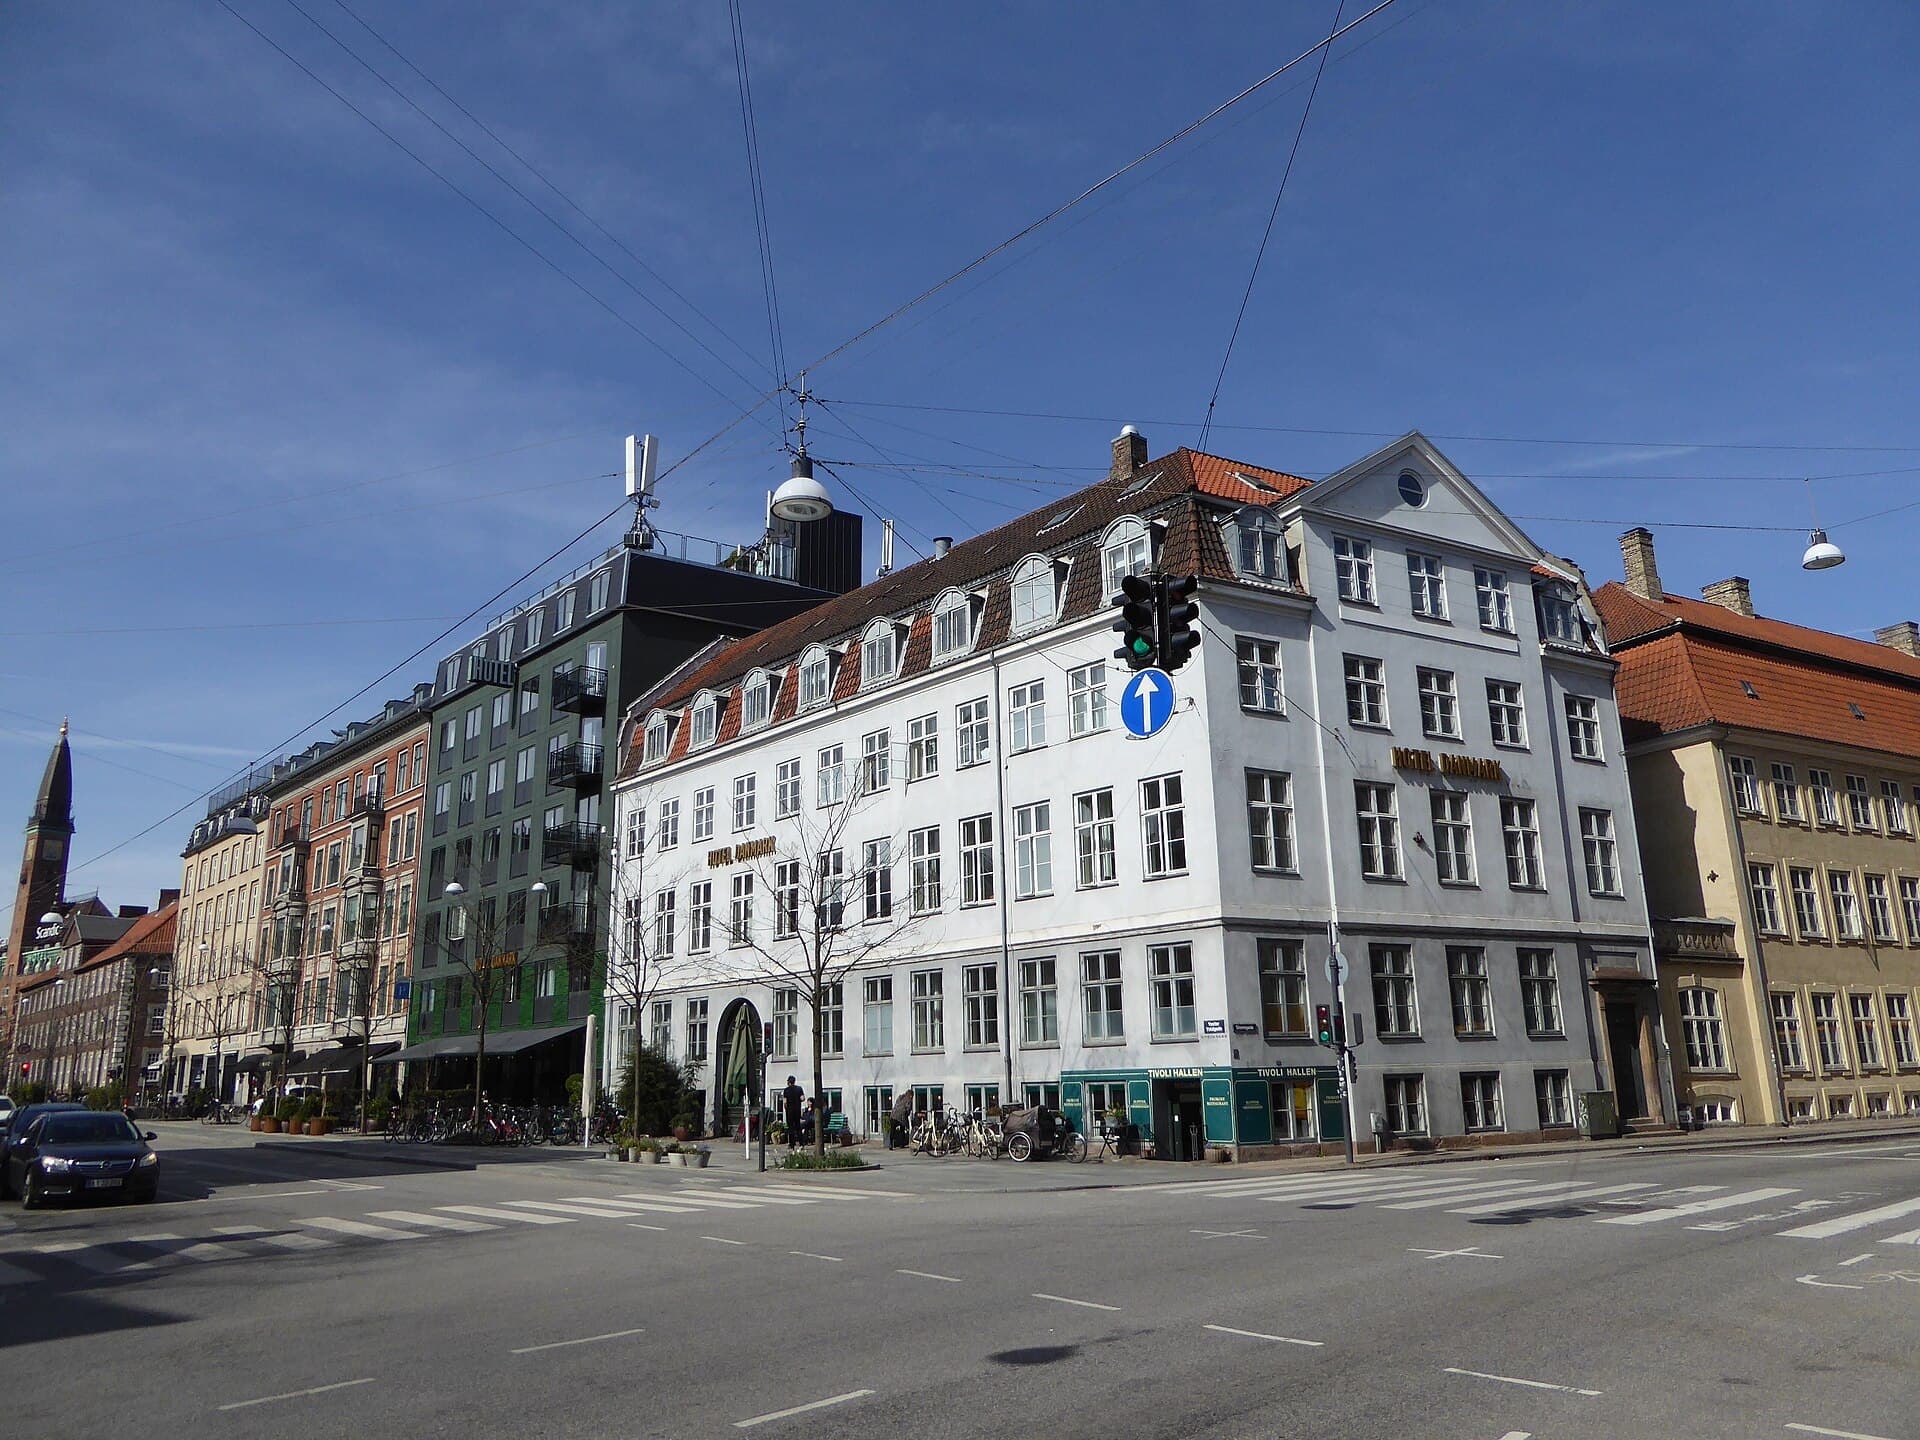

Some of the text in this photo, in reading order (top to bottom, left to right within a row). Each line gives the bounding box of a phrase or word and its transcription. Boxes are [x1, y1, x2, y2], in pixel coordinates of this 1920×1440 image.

[472, 655, 514, 685] HOTEL
[735, 836, 777, 862] DANMARK
[1148, 1068, 1203, 1078] TIVOLI HALLEN
[1257, 1067, 1316, 1077] TIVOLI HALLEN
